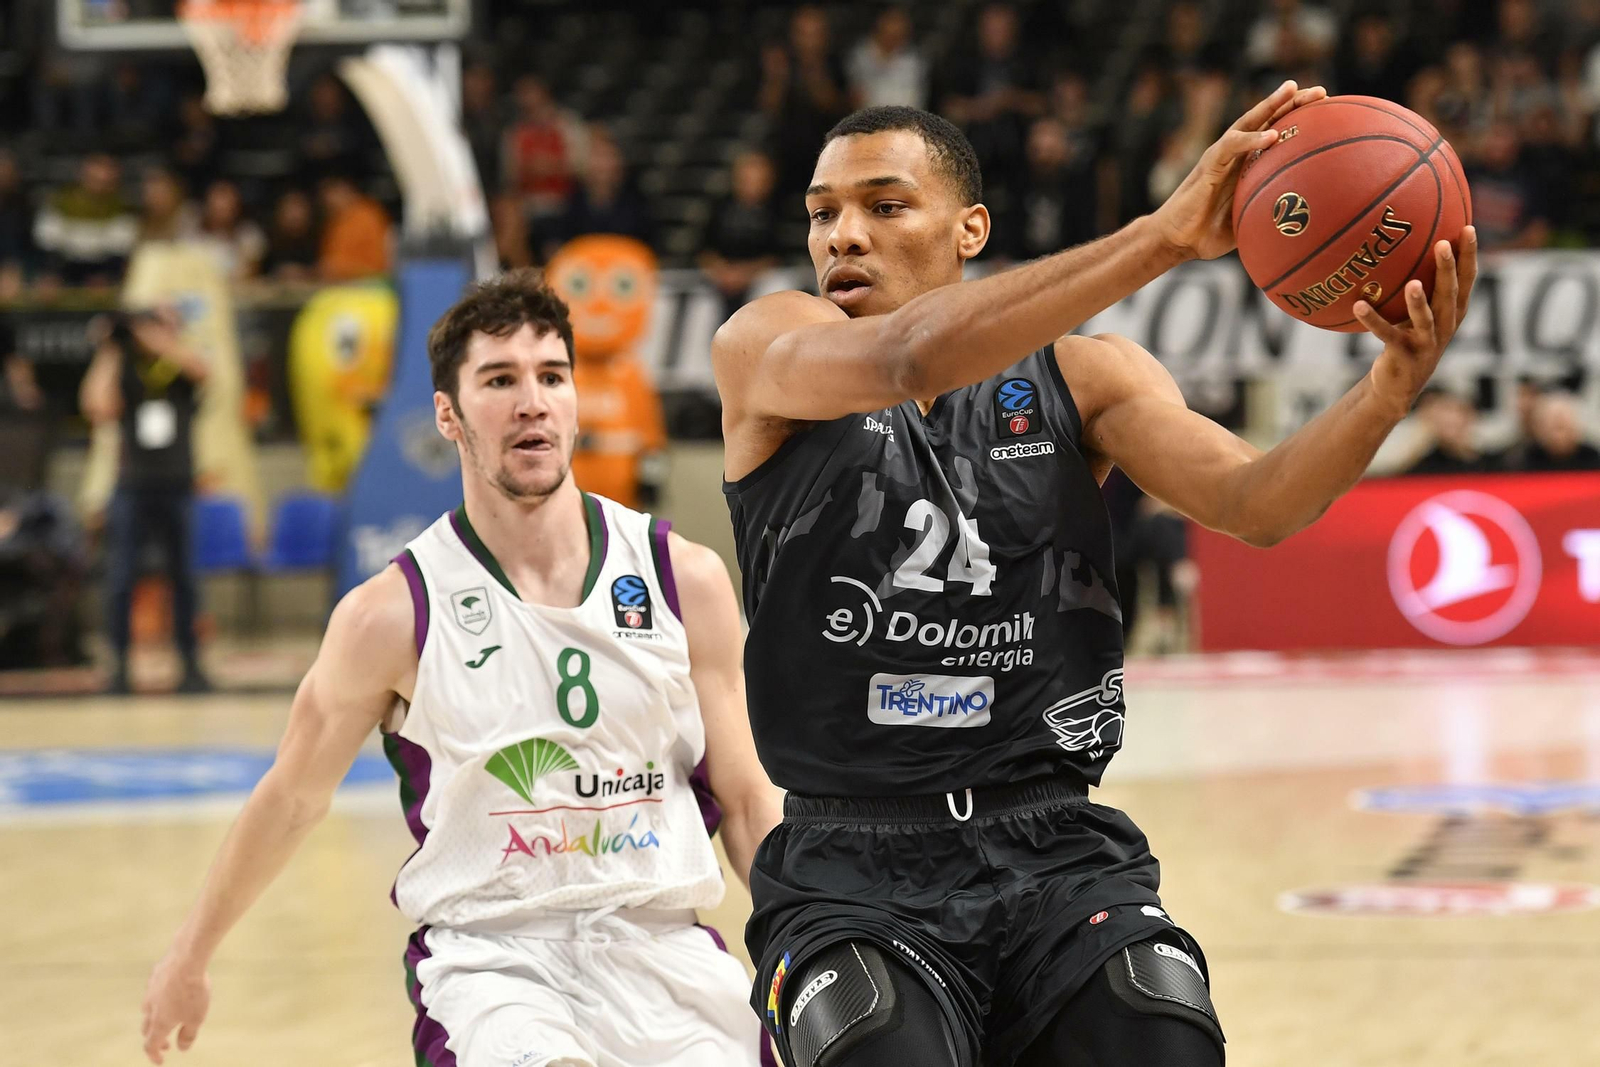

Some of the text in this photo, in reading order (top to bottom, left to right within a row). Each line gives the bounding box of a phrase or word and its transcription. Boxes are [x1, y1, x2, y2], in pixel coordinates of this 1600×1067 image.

[1281, 205, 1413, 316] SPALDING
[1002, 408, 1034, 419] EuroCup
[991, 442, 1054, 460] oneteam
[892, 498, 997, 597] 24
[556, 647, 600, 729] 8
[876, 684, 988, 718] TRENTINO
[575, 761, 664, 799] Unicaja
